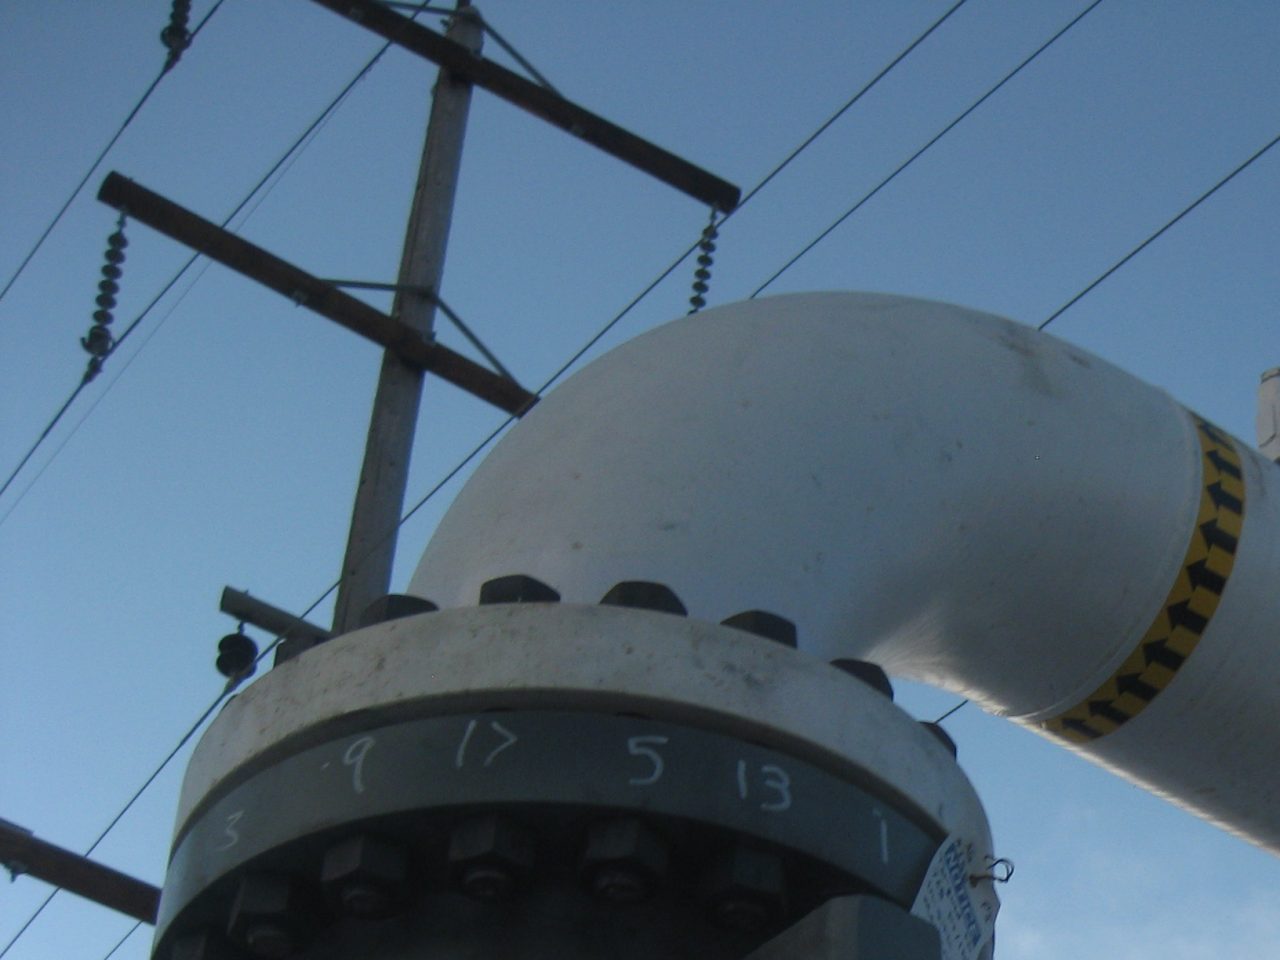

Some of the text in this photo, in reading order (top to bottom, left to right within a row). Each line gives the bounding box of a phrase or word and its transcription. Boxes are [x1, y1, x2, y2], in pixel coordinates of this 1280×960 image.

[343, 736, 377, 794] 9
[627, 736, 671, 786] 5
[736, 760, 793, 812] 13
